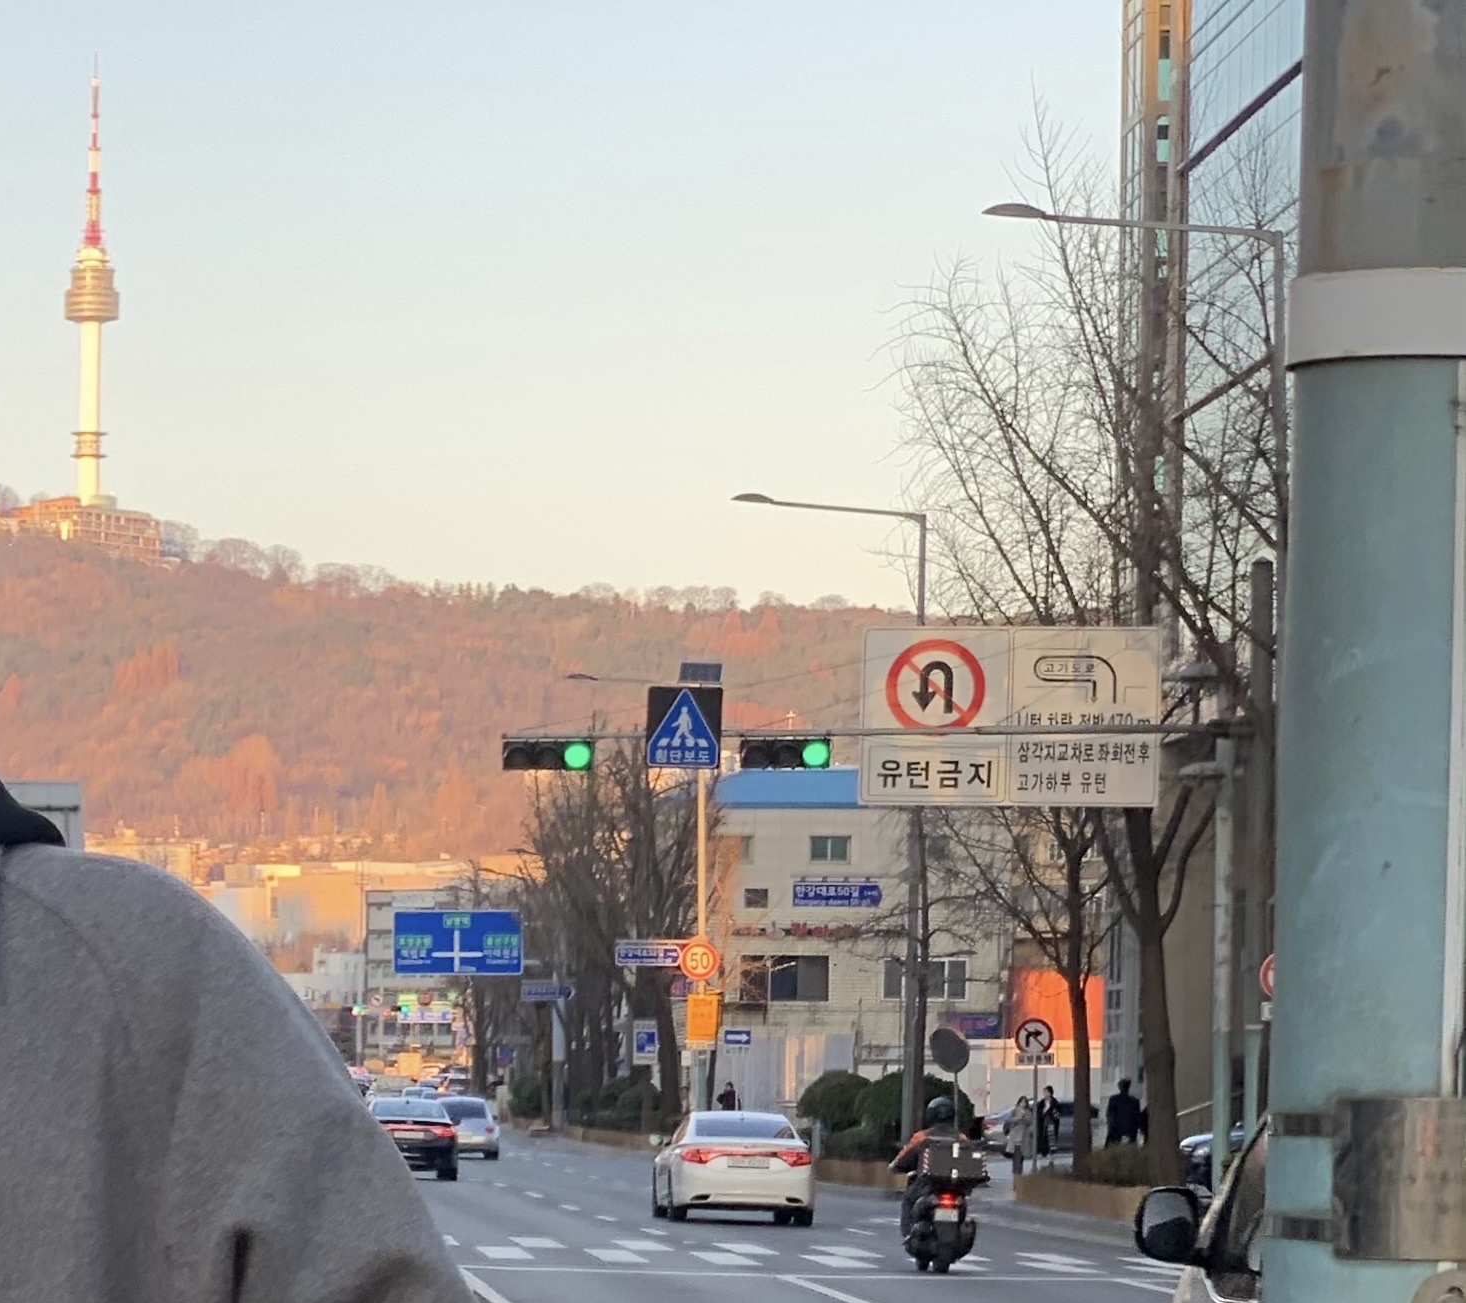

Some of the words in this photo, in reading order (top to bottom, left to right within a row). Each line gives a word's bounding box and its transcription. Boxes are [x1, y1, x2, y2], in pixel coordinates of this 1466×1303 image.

[1044, 663, 1095, 674] 고가도로
[1018, 742, 1094, 763] 삼각지교차로
[876, 759, 992, 789] 유턴금지
[1017, 771, 1072, 793] 고가하부
[1080, 771, 1107, 794] 유턴
[689, 952, 710, 970] 50
